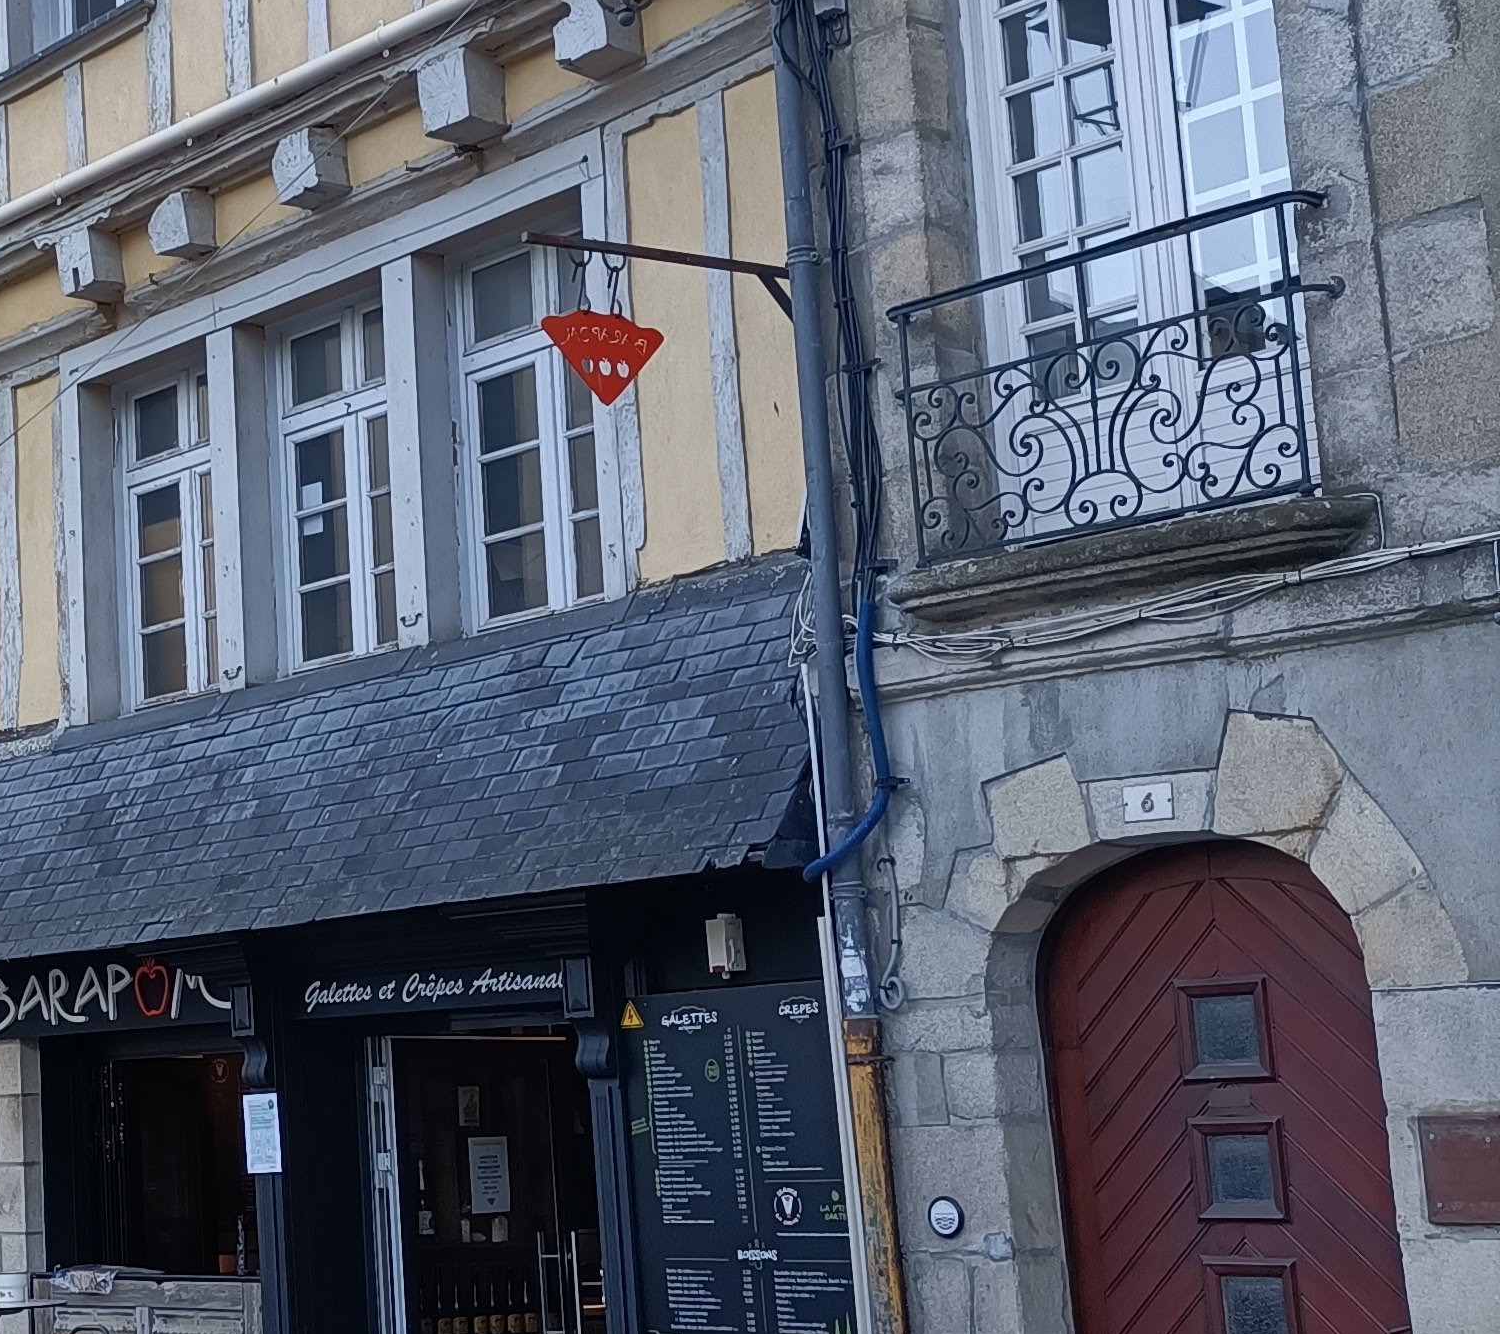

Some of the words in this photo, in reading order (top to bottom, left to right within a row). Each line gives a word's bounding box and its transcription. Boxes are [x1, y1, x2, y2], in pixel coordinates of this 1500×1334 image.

[1141, 792, 1154, 813] 6
[304, 980, 372, 1013] Galettes
[378, 979, 396, 1000] et
[402, 972, 464, 1003] Crêpes
[778, 1001, 819, 1016] CREPES
[661, 1011, 718, 1027] GALETTES
[737, 1249, 778, 1261] BOISSONS
